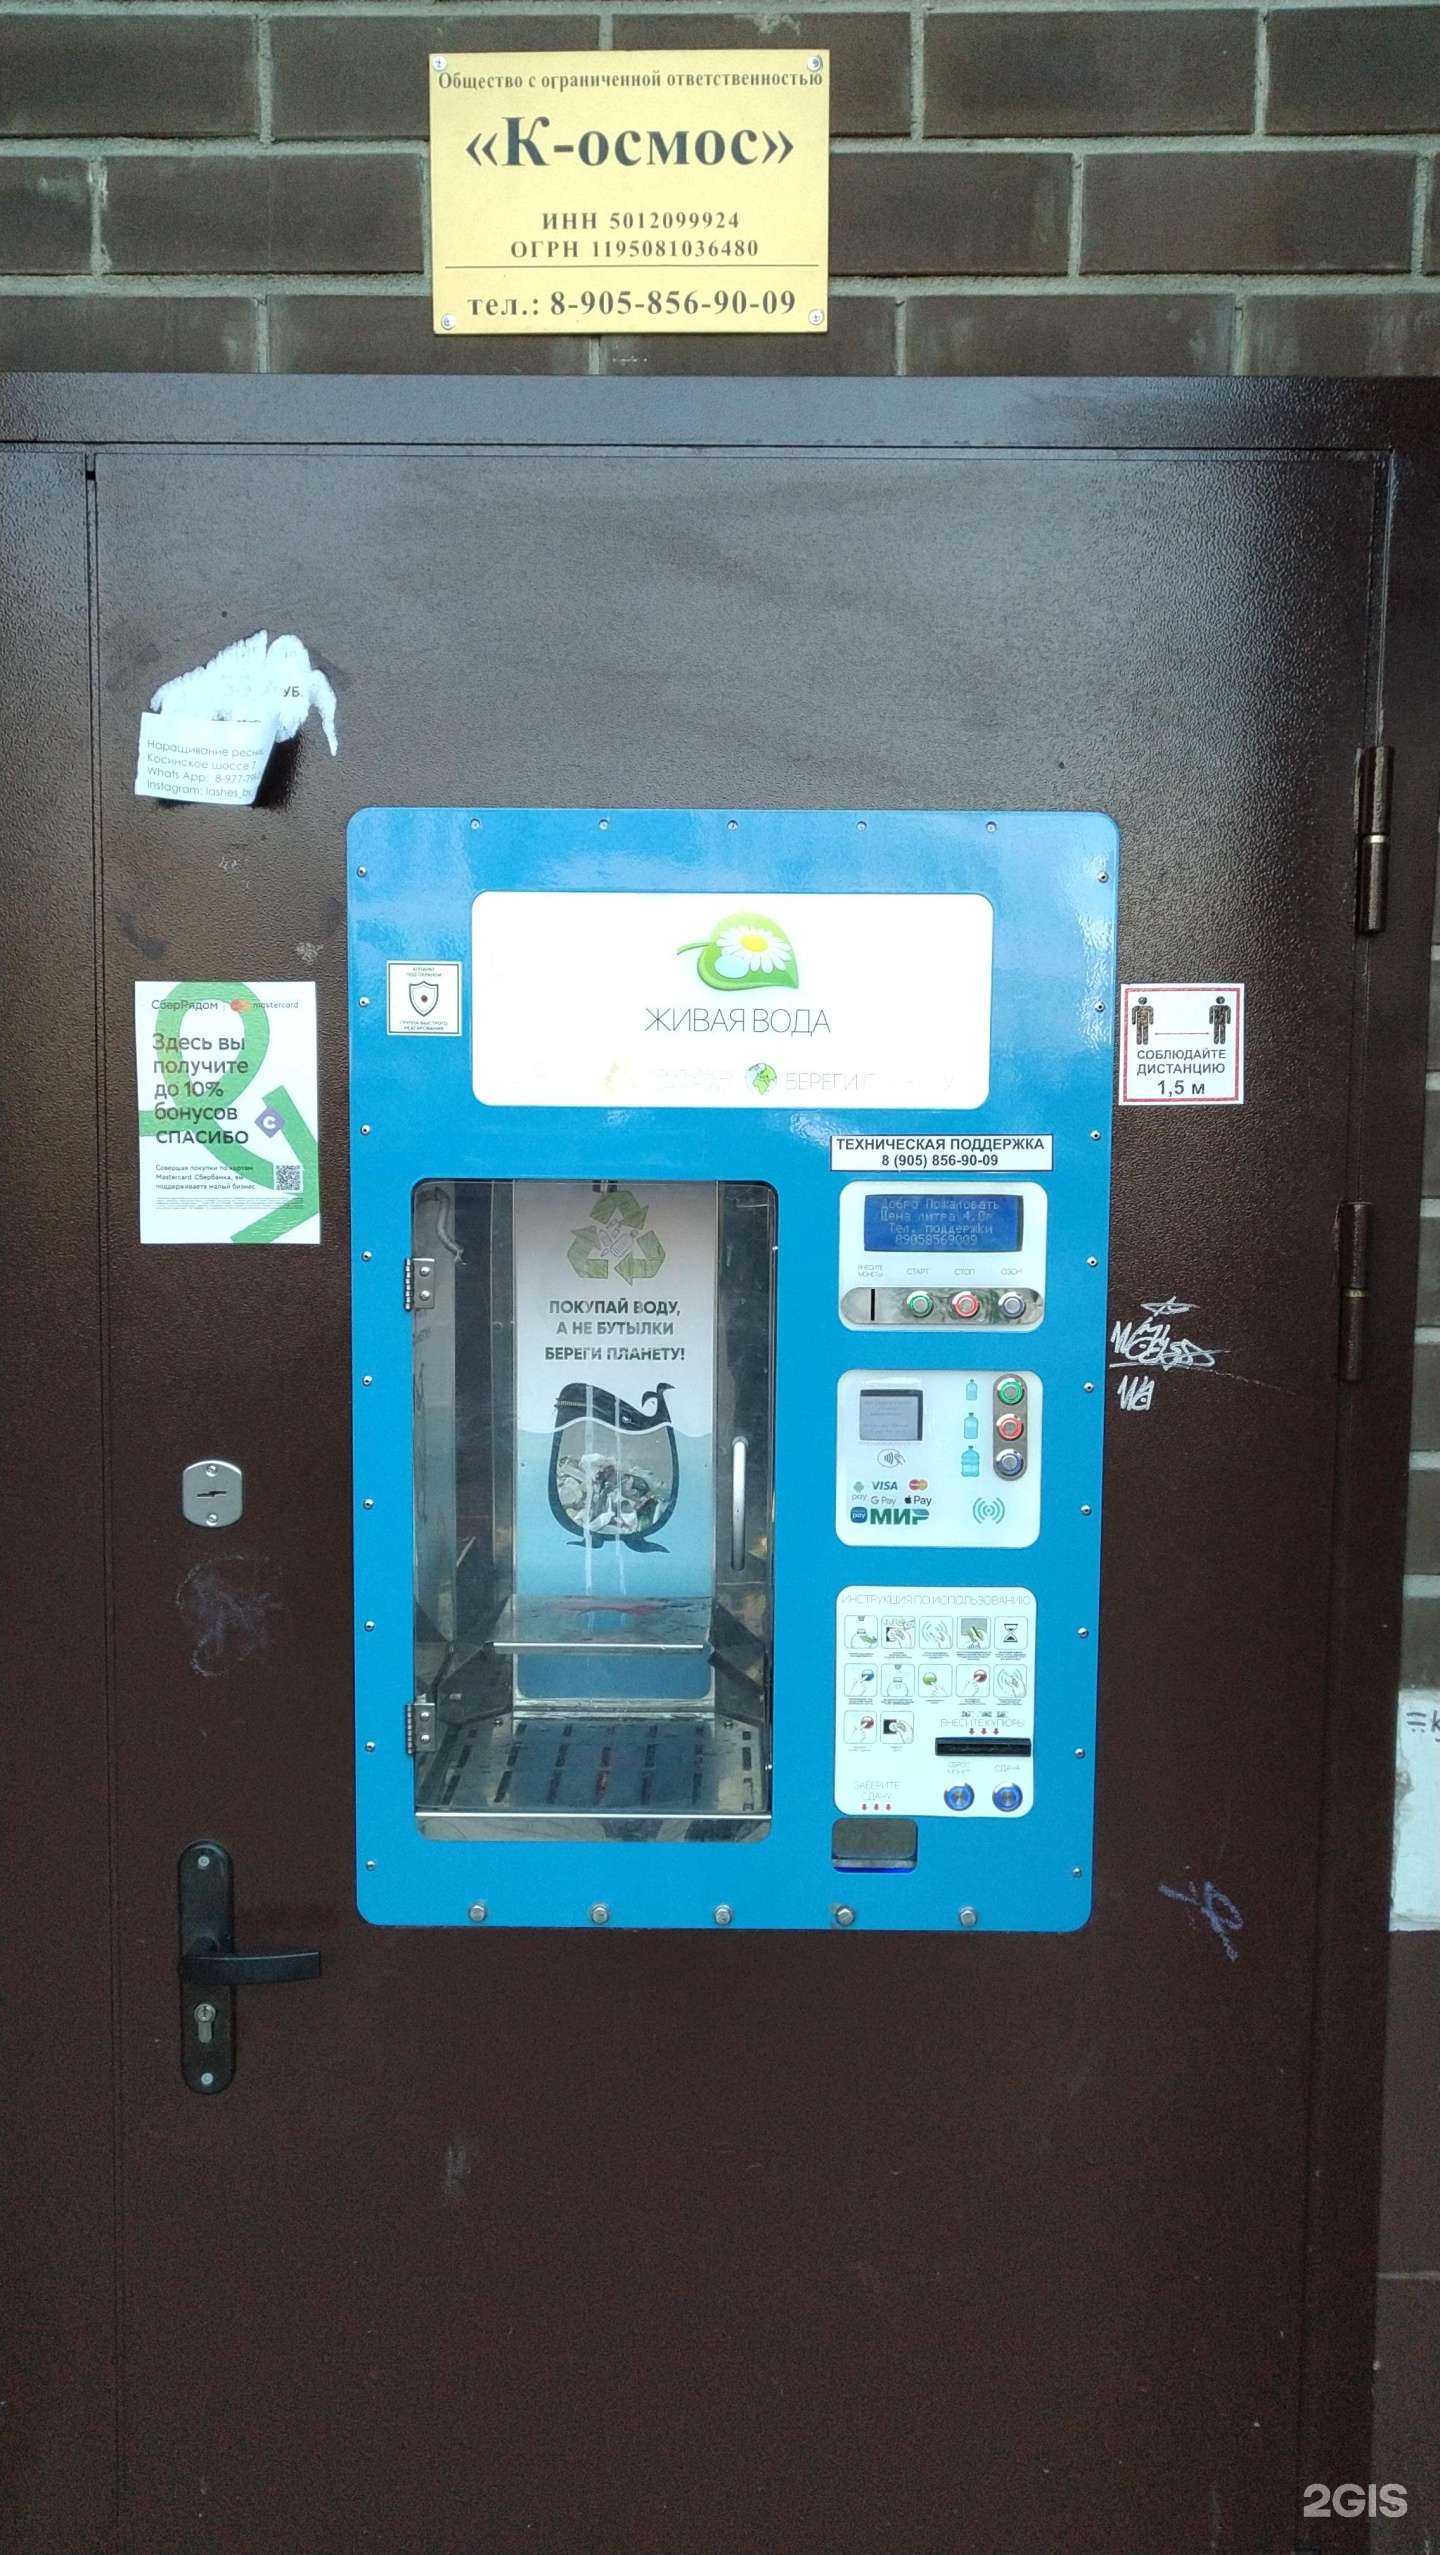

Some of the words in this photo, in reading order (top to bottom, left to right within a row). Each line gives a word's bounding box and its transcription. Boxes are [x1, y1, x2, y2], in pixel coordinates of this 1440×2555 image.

[438, 71, 523, 90] Общество
[528, 76, 537, 88] с
[541, 70, 662, 92] ограниченной
[667, 70, 823, 88] ответственностью
[465, 116, 795, 167] «К-осмос»
[542, 212, 598, 231] ИНН
[609, 211, 740, 230] 5012099924
[510, 241, 579, 258] ОГРН
[592, 239, 759, 258] 1195081036480
[467, 295, 540, 317] тел.:
[550, 290, 796, 316] 8-905-856-90-09
[147, 739, 229, 758] Наращивание
[147, 754, 208, 770] Косинское
[211, 760, 250, 772] шоссе
[147, 766, 180, 780] Whats
[147, 779, 202, 797] Instagram:
[151, 1000, 218, 1012] СберРядом
[252, 1000, 299, 1010] mastercard
[644, 1007, 746, 1034] ЖИВАЯ
[752, 1007, 831, 1037] ВОДА
[153, 1033, 212, 1051] Здесь
[219, 1037, 245, 1050] вы
[1137, 1047, 1227, 1061] СОБЛЮДАЙТЕ
[153, 1058, 249, 1077] получите
[1136, 1063, 1226, 1076] ДИСТАНЦИЮ
[154, 1083, 179, 1100] до
[184, 1081, 224, 1098] 10%
[1157, 1079, 1184, 1097] 1,5
[1192, 1083, 1205, 1095] м
[154, 1102, 238, 1126] бонусов
[156, 1130, 249, 1145] СПАСИБО
[836, 1138, 945, 1151] ТЕХНИЧЕСКАЯ
[950, 1138, 1045, 1152] ПОДДЕРЖКА
[881, 1154, 890, 1166] 8
[894, 1154, 928, 1168] (905)
[932, 1154, 999, 1167] 856-90-09
[549, 1298, 629, 1315] ПОКУПАЙ
[633, 1300, 681, 1317] ВОДУ,
[556, 1322, 567, 1335] А
[572, 1322, 593, 1335] НЕ
[597, 1322, 674, 1335] БУТЫЛКИ
[545, 1347, 602, 1361] БЕРЕГИ
[606, 1347, 685, 1361] ПЛАНЕТУ!
[872, 1480, 898, 1490] VISA
[913, 1495, 932, 1507] Pay
[870, 1508, 930, 1525] МИР
